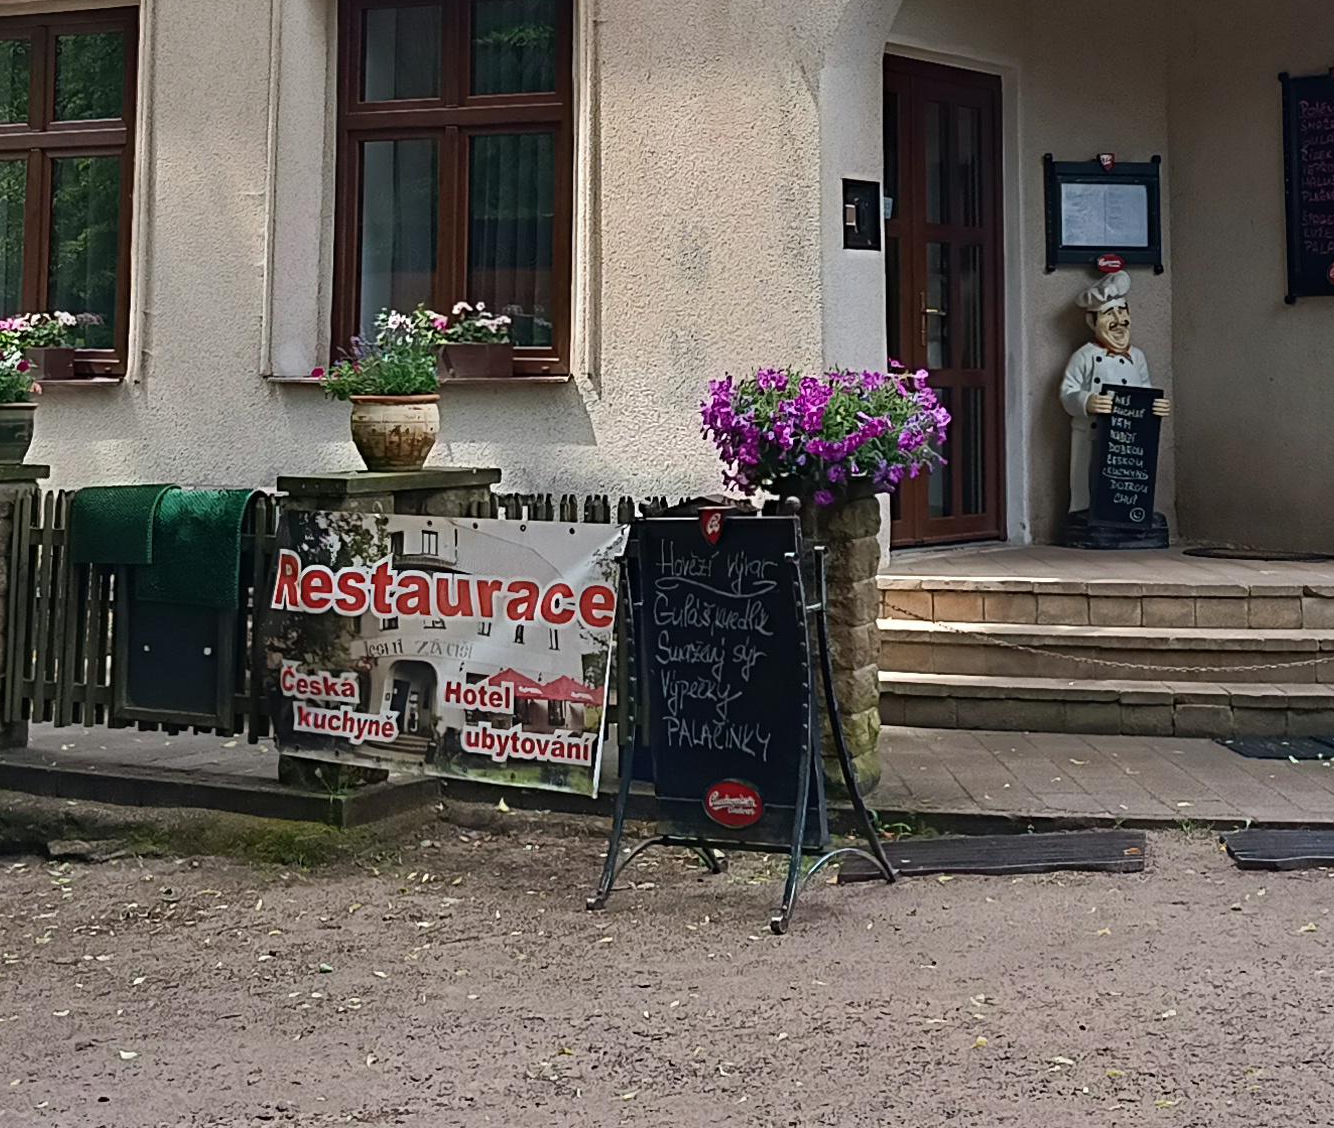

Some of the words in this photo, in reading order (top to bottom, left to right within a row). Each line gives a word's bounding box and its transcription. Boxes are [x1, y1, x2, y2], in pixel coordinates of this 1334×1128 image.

[273, 553, 616, 629] Restaurace
[281, 665, 357, 699] Česká
[444, 681, 512, 710] Hotel
[297, 705, 396, 741] kuchyně
[662, 716, 771, 762] PALAČINKY
[466, 726, 593, 761] ubytování
